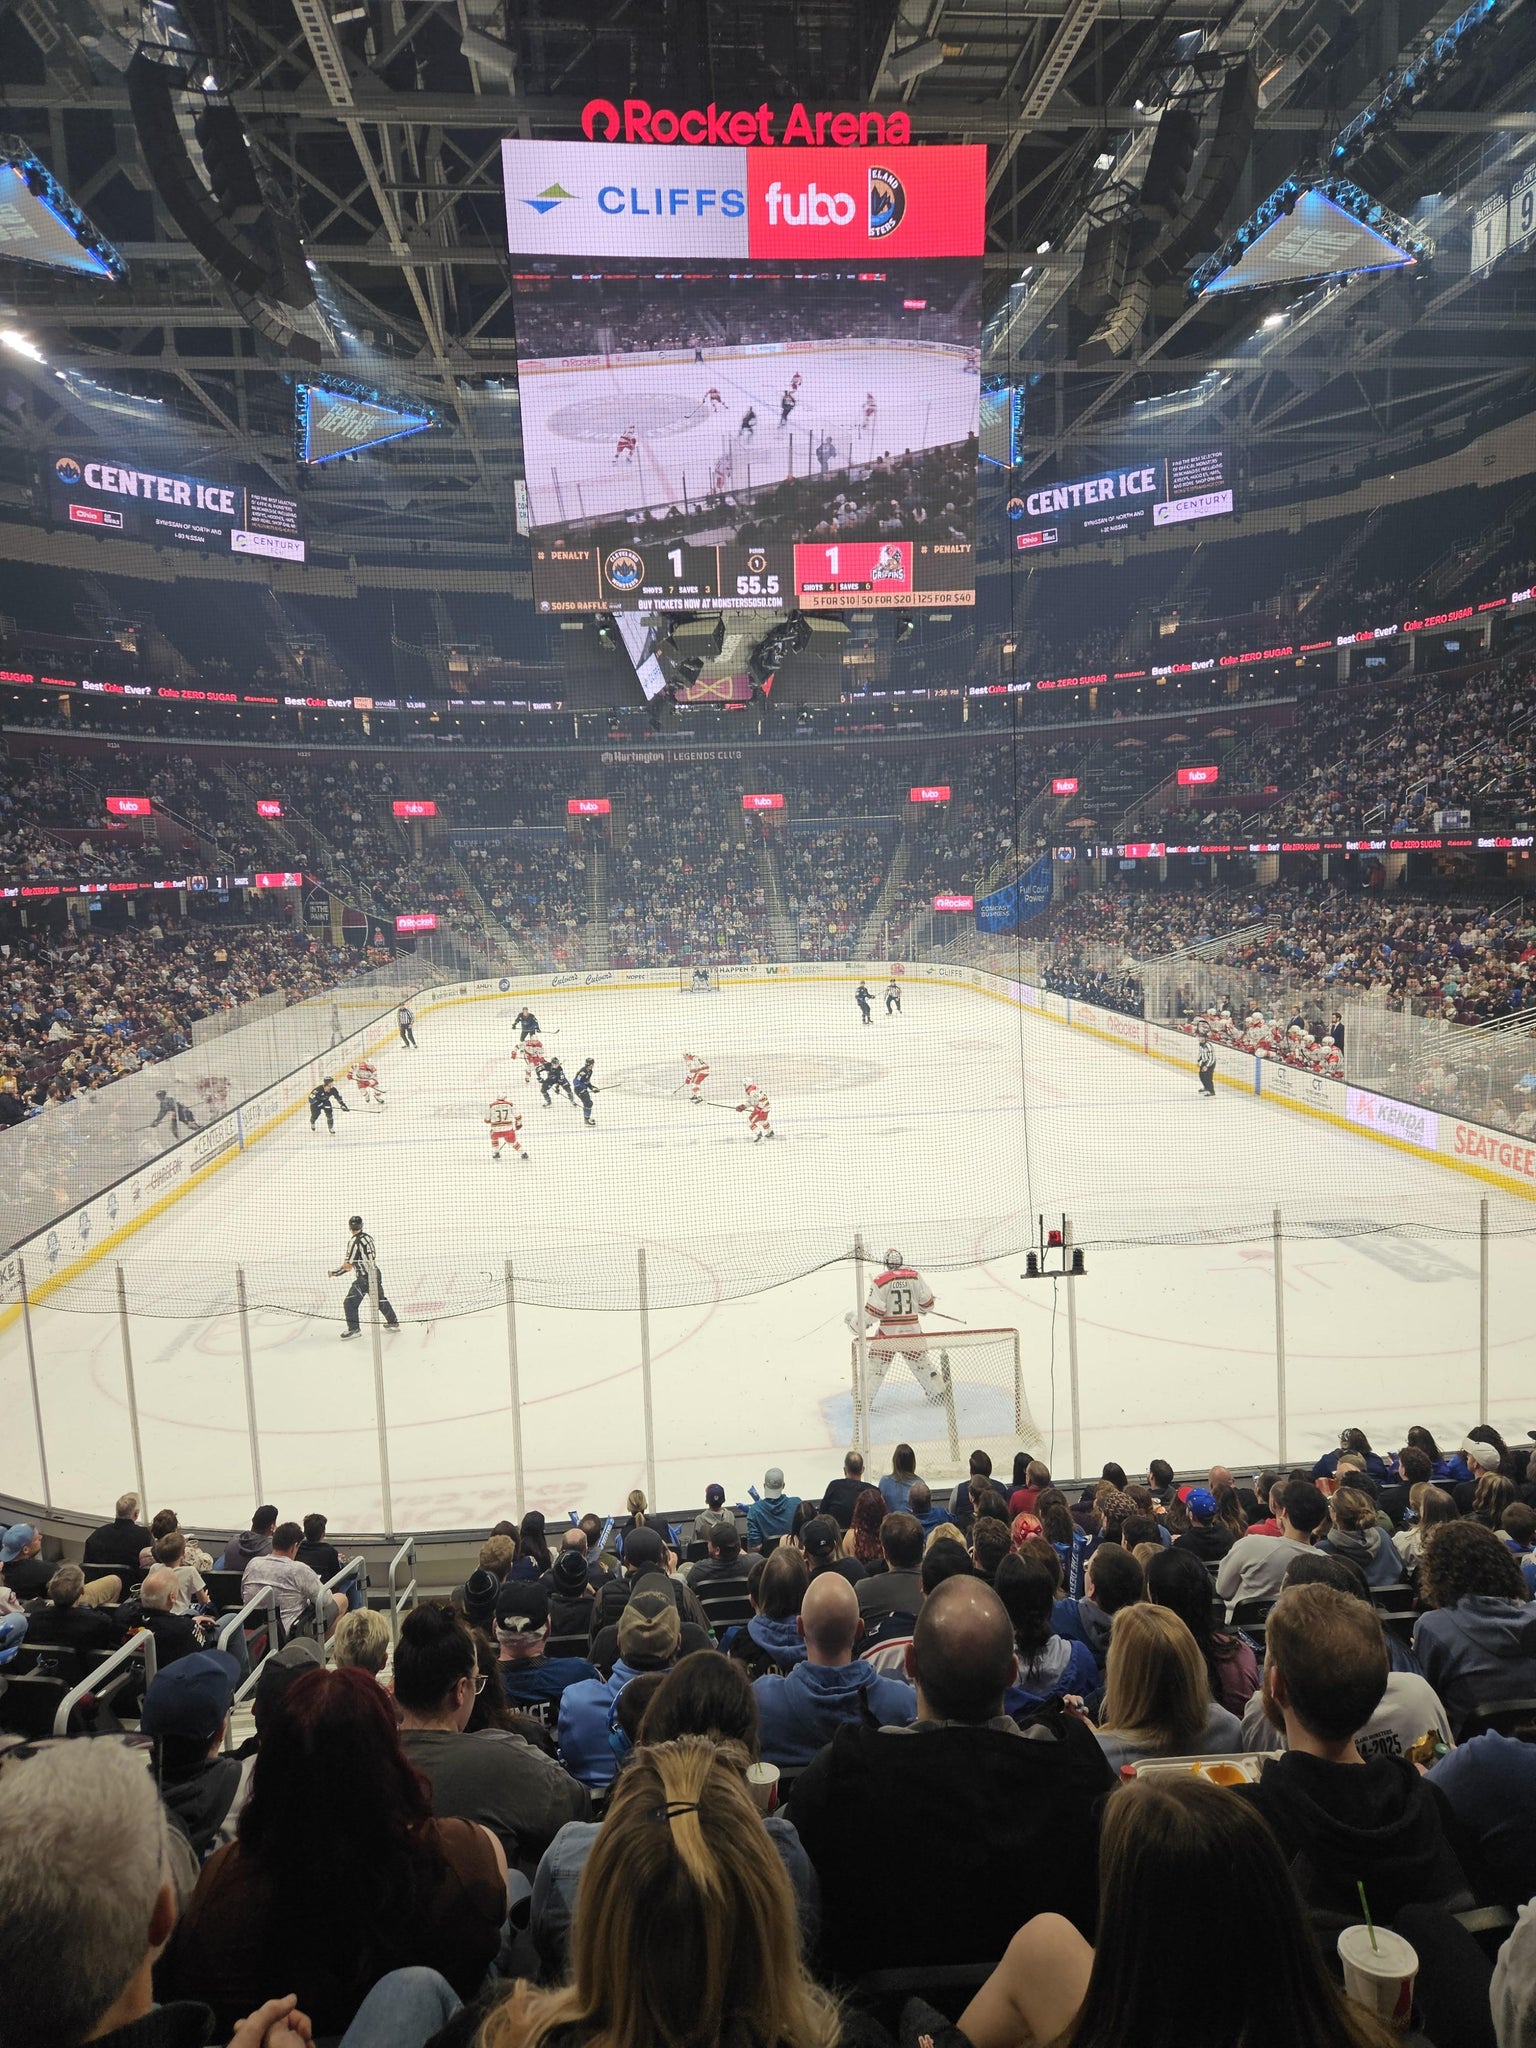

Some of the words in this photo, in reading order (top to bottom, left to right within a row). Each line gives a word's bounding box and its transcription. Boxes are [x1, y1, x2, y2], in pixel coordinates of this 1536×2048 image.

[624, 100, 774, 144] Rocket
[783, 103, 911, 145] Arena
[598, 186, 745, 217] CLIFFS
[765, 182, 856, 225] fubo
[1475, 194, 1504, 222] BOWER
[1521, 190, 1534, 232] 9
[1484, 220, 1492, 259] 1
[316, 412, 376, 441] DEPTHS
[84, 463, 191, 507] CENTER
[196, 484, 235, 515] ICE
[1026, 478, 1115, 516] CENTER
[1119, 467, 1157, 497] ICE
[1176, 494, 1228, 511] CENTURY
[75, 510, 98, 521] Ohio
[253, 536, 300, 550] CENTURY
[1022, 536, 1038, 545] Ohio
[934, 544, 971, 554] PENALTY
[551, 551, 589, 560] PENALTY
[825, 545, 839, 575] 1
[667, 548, 682, 578] 1
[754, 560, 760, 568] 1
[871, 568, 905, 581] GRIFFINS
[642, 586, 663, 594] SHOTS
[668, 586, 674, 594] 7
[678, 586, 699, 594] SAVES
[705, 586, 711, 594] 3
[736, 575, 779, 595] 55.5
[803, 583, 823, 591] SHOTS
[829, 583, 834, 591] 4
[839, 583, 859, 591] SAVES
[865, 582, 871, 590] 6
[813, 597, 819, 605] 5
[821, 597, 837, 605] FOR
[840, 596, 855, 605] $10
[861, 596, 873, 605] 50
[875, 596, 892, 604] FOR
[894, 595, 911, 605] $20
[918, 595, 932, 604] 125
[935, 595, 951, 603] FOR
[954, 594, 971, 603] $40
[1511, 588, 1531, 602] Best
[551, 602, 575, 610] 50/50
[577, 601, 608, 610] RAFFLE
[638, 599, 653, 610] BUY
[654, 599, 683, 610] TICKETS
[684, 599, 700, 609] NOW
[701, 598, 711, 609] AT
[712, 597, 783, 609] MONSTERS5050.COM
[1403, 619, 1423, 632] Coke
[1424, 614, 1448, 627] ZERO
[1448, 606, 1473, 621] SUGAR
[1337, 635, 1356, 646] Best
[1356, 631, 1374, 642] Coke
[1374, 624, 1398, 638] Ever?
[1219, 655, 1239, 666] Coke
[1239, 650, 1262, 662] ZERO
[1263, 646, 1293, 659] SUGAR
[1152, 665, 1172, 676] Best
[1172, 663, 1191, 674] Coke
[1191, 658, 1215, 670] Ever?
[0, 671, 34, 683] SUGAR
[1036, 680, 1056, 690] Coke
[1057, 677, 1079, 688] ZERO
[1079, 674, 1107, 686] SUGAR
[82, 680, 103, 691] Best
[104, 683, 124, 694] Coke
[124, 684, 151, 696] Ever?
[969, 686, 988, 696] Best
[988, 684, 1007, 694] Coke
[1007, 682, 1031, 692] Ever?
[158, 687, 180, 698] Coke
[181, 690, 205, 700] ZERO
[207, 691, 237, 702] SUGAR
[284, 696, 306, 706] Best
[327, 698, 351, 708] Ever?
[556, 702, 562, 710] 7
[614, 752, 664, 763] Huntington
[673, 752, 715, 761] LEGENDS
[717, 751, 742, 760] CLUB
[1188, 771, 1207, 781] fubo
[1056, 781, 1074, 791] fubo
[921, 789, 939, 798] fubo
[119, 801, 139, 811] fubo
[579, 802, 598, 811] fubo
[754, 797, 772, 806] fubo
[261, 803, 281, 813] fubo
[404, 803, 424, 813] fubo
[1390, 840, 1404, 849] Coke
[1404, 840, 1420, 849] ZERO
[1420, 839, 1442, 848] SUGAR
[1477, 838, 1495, 847] Best
[1495, 837, 1511, 846] Coke
[1511, 836, 1534, 846] Ever?
[1020, 886, 1031, 894] Full
[1032, 885, 1049, 894] Court
[943, 899, 971, 908] Rocket
[407, 917, 434, 927] Rocket
[939, 968, 963, 978] CLIFFS
[495, 1109, 508, 1122] 37
[1378, 1105, 1425, 1134] KENDA
[198, 1122, 222, 1155] CENTER
[892, 1281, 908, 1289] COSSA
[891, 1290, 912, 1315] 33
